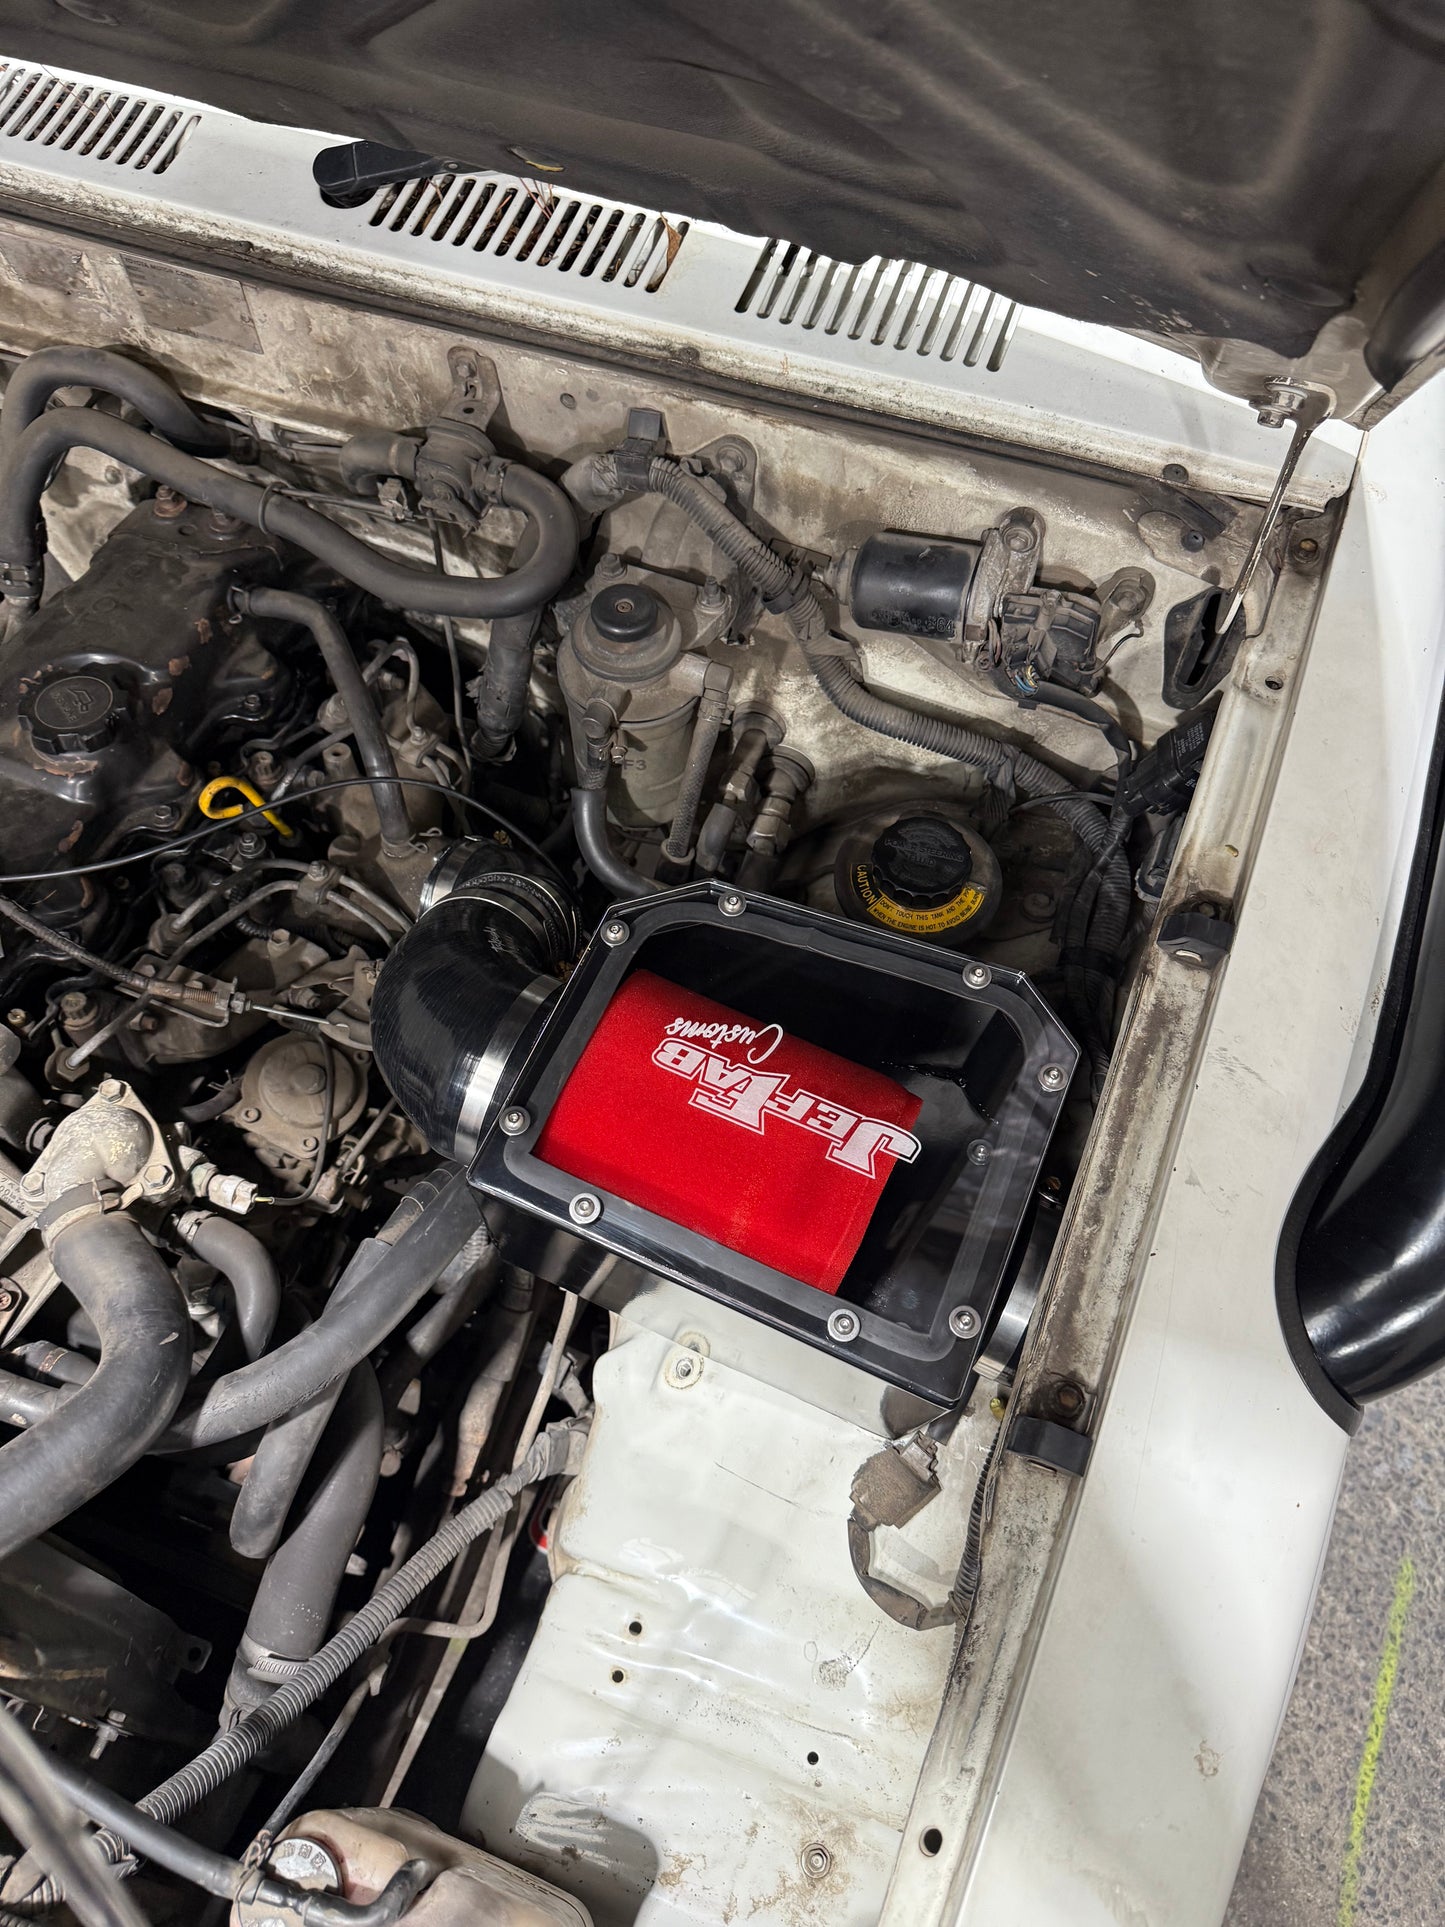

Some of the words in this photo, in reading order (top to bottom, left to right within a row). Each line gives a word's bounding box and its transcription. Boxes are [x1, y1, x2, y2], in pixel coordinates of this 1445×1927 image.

[124, 257, 150, 270] TOYOTA
[910, 854, 936, 867] FLUID
[919, 845, 965, 863] STEERING
[856, 864, 878, 905] CAUTION
[872, 908, 887, 920] WHEN
[886, 917, 897, 926] THE
[897, 921, 917, 931] ENGINE
[937, 920, 946, 929] TO
[946, 914, 961, 926] AVOID
[895, 908, 914, 920] TOUCH
[915, 913, 929, 921] THIS
[930, 911, 945, 920] TANK
[945, 905, 956, 915] AND
[664, 1017, 784, 1064] Customs
